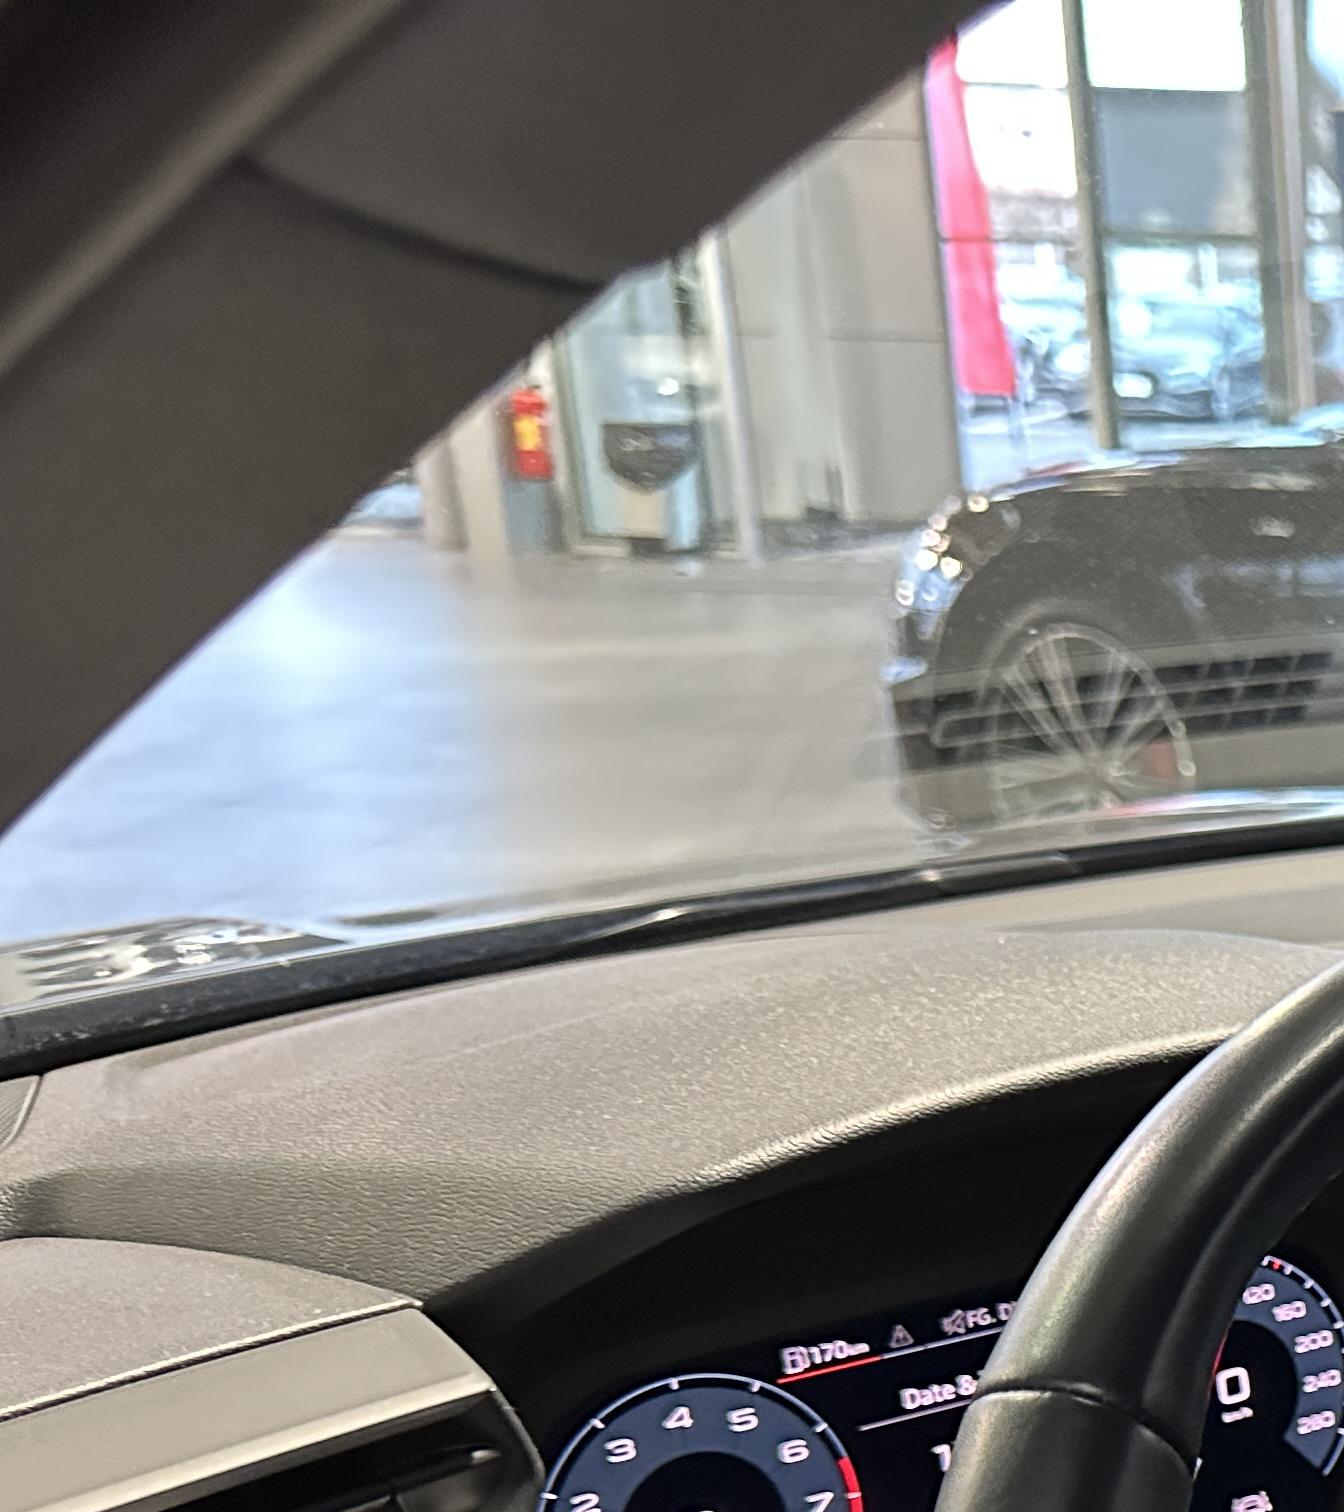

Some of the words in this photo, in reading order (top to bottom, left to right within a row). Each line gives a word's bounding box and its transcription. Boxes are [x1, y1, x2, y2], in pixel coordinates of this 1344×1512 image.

[1295, 1330, 1333, 1353] 200
[900, 1384, 956, 1410] Date
[1216, 1367, 1250, 1404] 0
[661, 1406, 694, 1430] 4
[726, 1407, 759, 1432] 5
[604, 1438, 637, 1463] 3
[777, 1439, 809, 1464] 6
